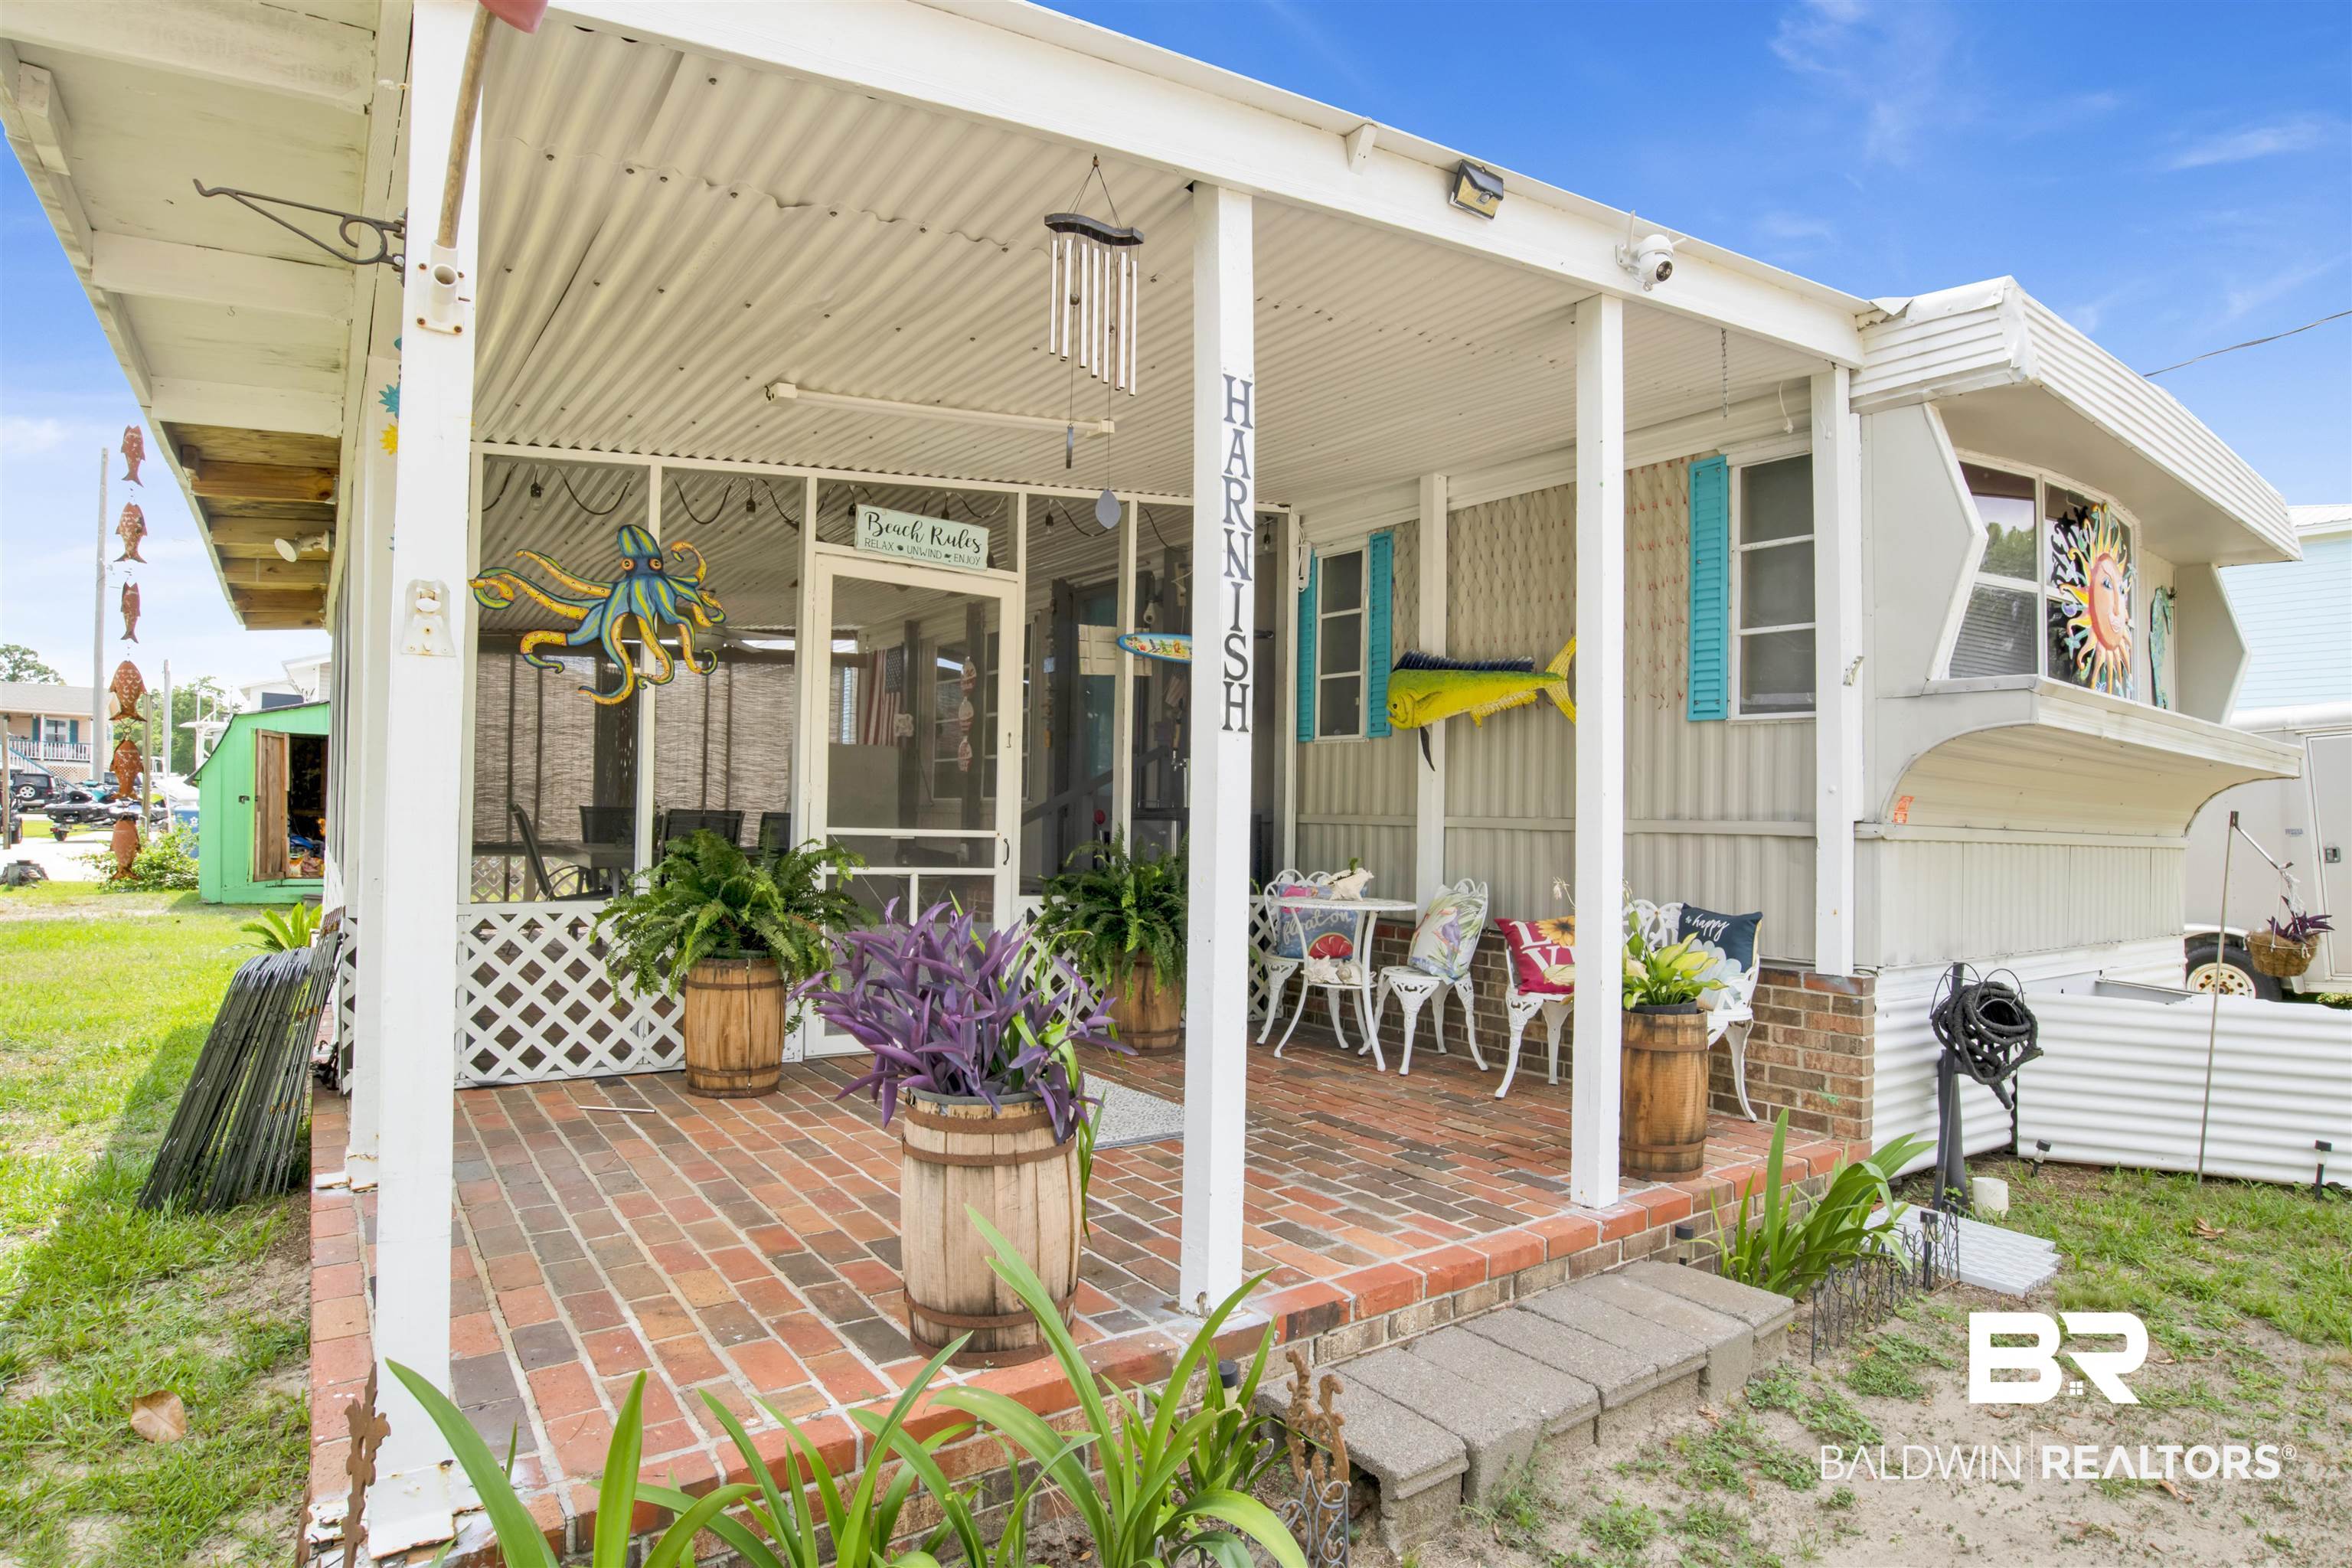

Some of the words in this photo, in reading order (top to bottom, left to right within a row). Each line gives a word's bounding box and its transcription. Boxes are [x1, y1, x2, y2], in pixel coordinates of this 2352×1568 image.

[864, 511, 925, 543] Beach
[930, 525, 982, 554] Rules
[864, 538, 894, 551] RELAX
[906, 545, 942, 559] UNWIND
[953, 554, 981, 566] ENJOY
[1222, 374, 1253, 732] HARNISH
[1282, 909, 1323, 945] flat
[1329, 910, 1352, 923] on
[1692, 913, 1730, 942] happy
